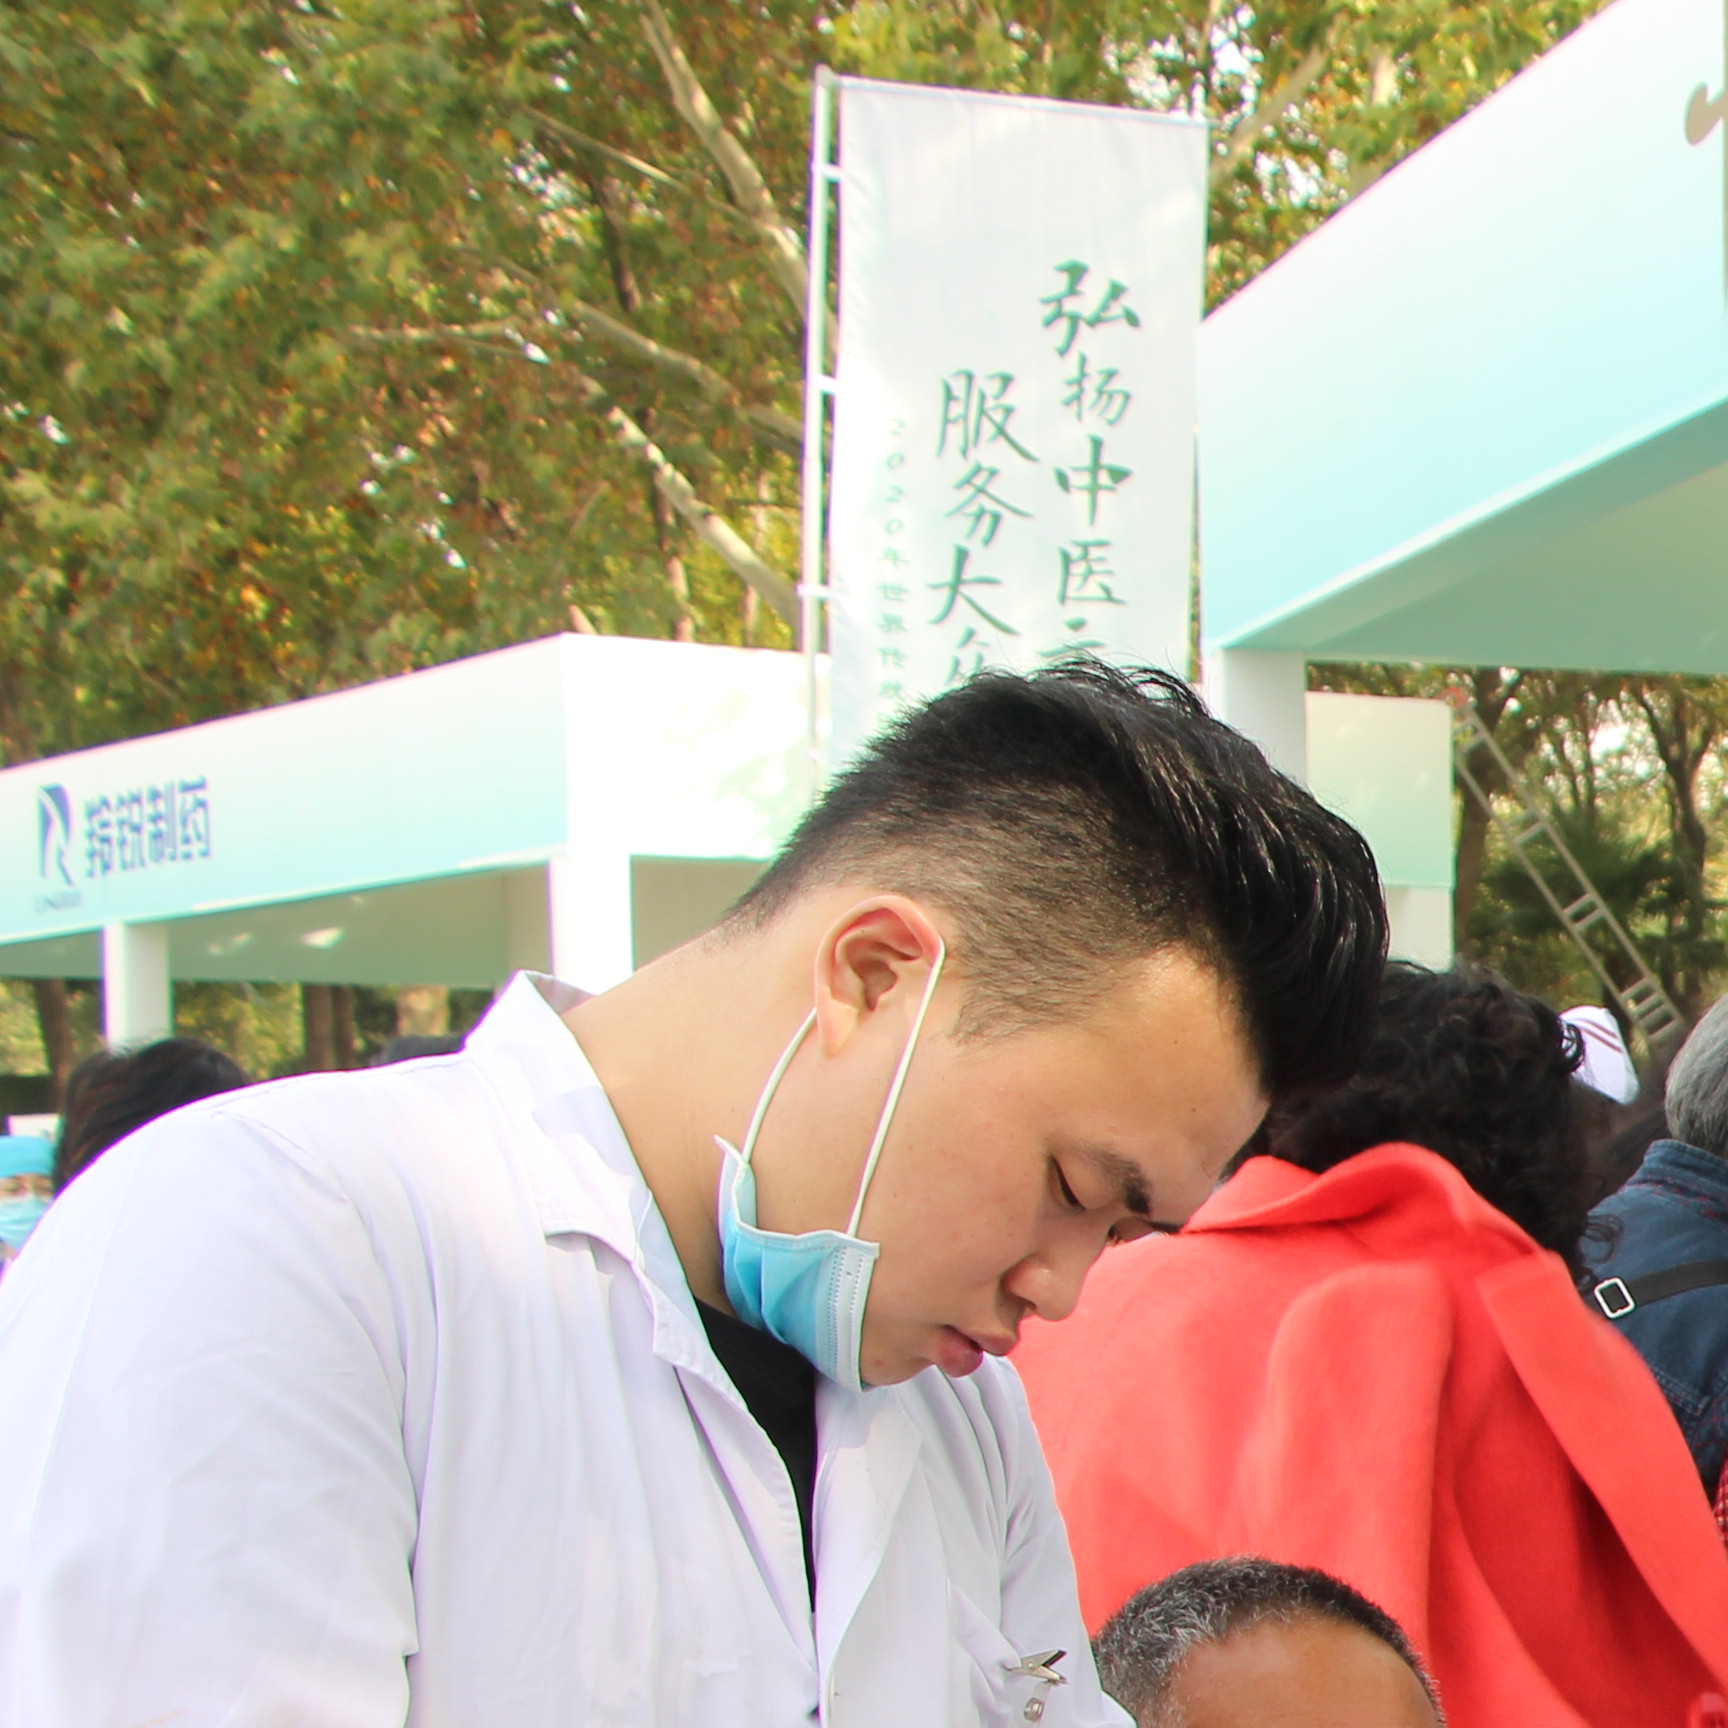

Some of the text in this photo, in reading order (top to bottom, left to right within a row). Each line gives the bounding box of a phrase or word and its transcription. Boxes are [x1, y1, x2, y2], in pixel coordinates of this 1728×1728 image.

[876, 416, 908, 715] 2020年世界传统
